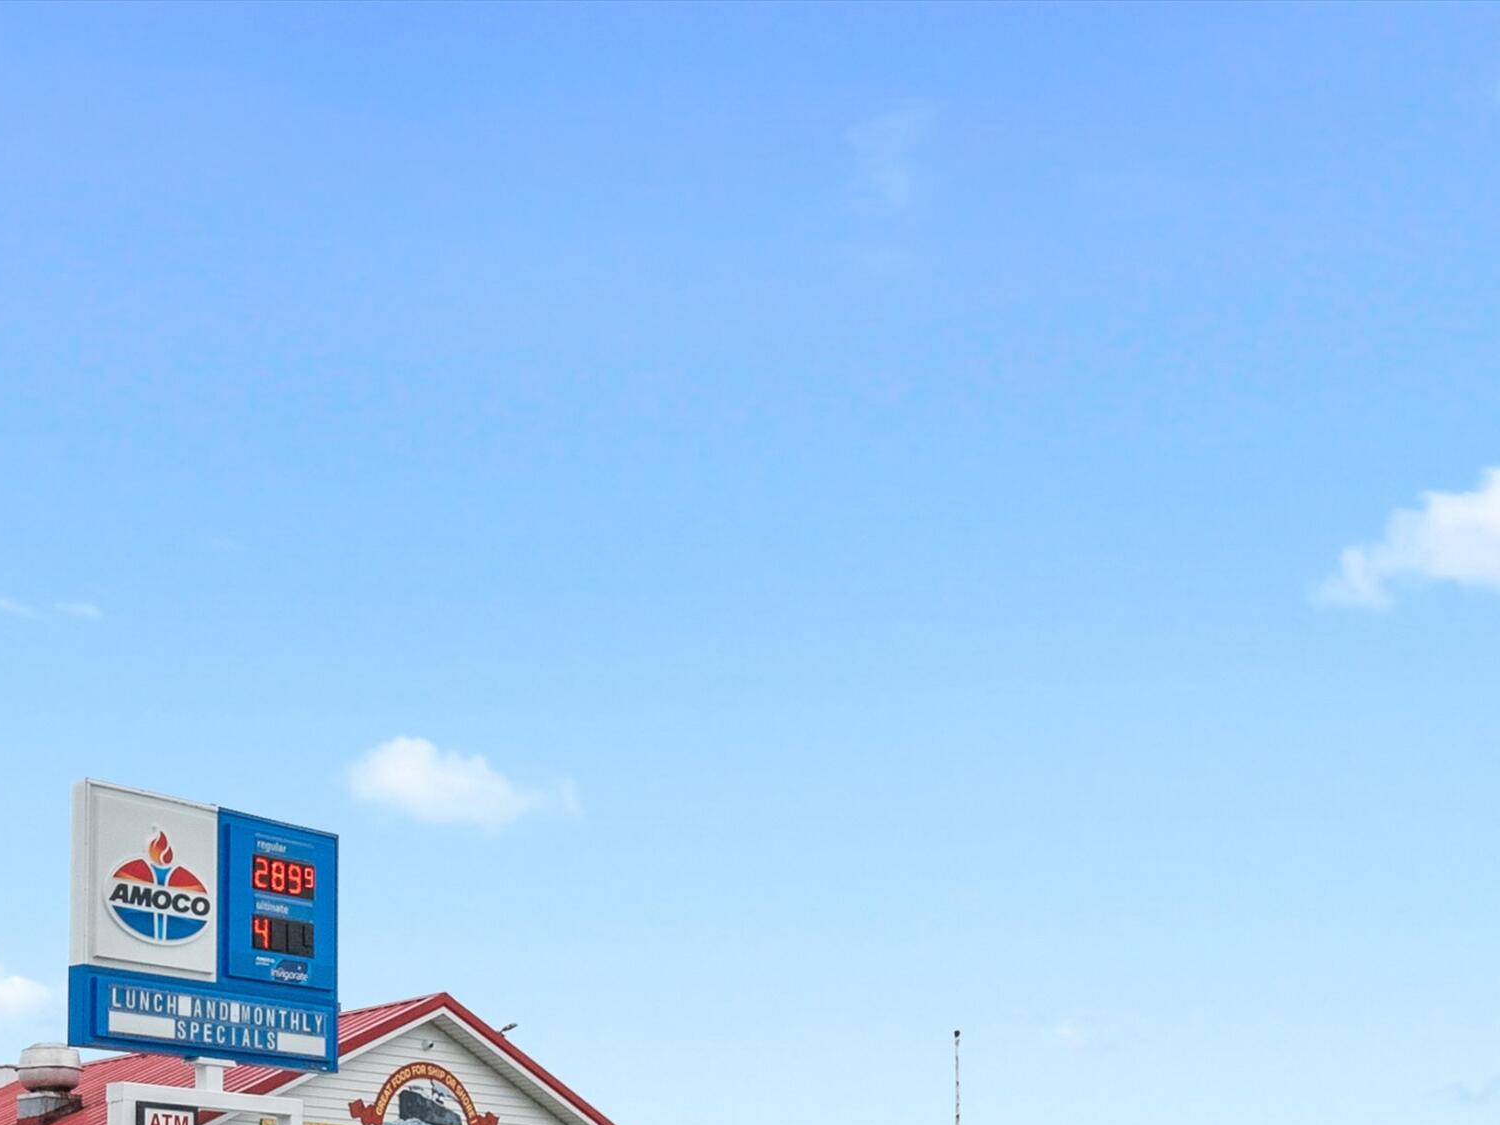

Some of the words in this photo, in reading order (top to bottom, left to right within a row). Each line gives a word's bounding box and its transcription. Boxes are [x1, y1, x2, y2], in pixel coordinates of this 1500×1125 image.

[256, 839, 286, 854] regular
[109, 883, 210, 916] AMOCO
[255, 900, 289, 916] ultimate
[254, 918, 269, 949] 4
[111, 987, 178, 1014] LUNCH
[194, 999, 231, 1020] AND
[241, 1002, 324, 1033] MONTHLY
[176, 1020, 277, 1050] SPECIALS
[376, 1085, 394, 1115] GREAT
[392, 1068, 411, 1088] FOOD
[411, 1065, 427, 1076] FOR
[427, 1065, 446, 1079] SHIP
[445, 1075, 457, 1088] OR
